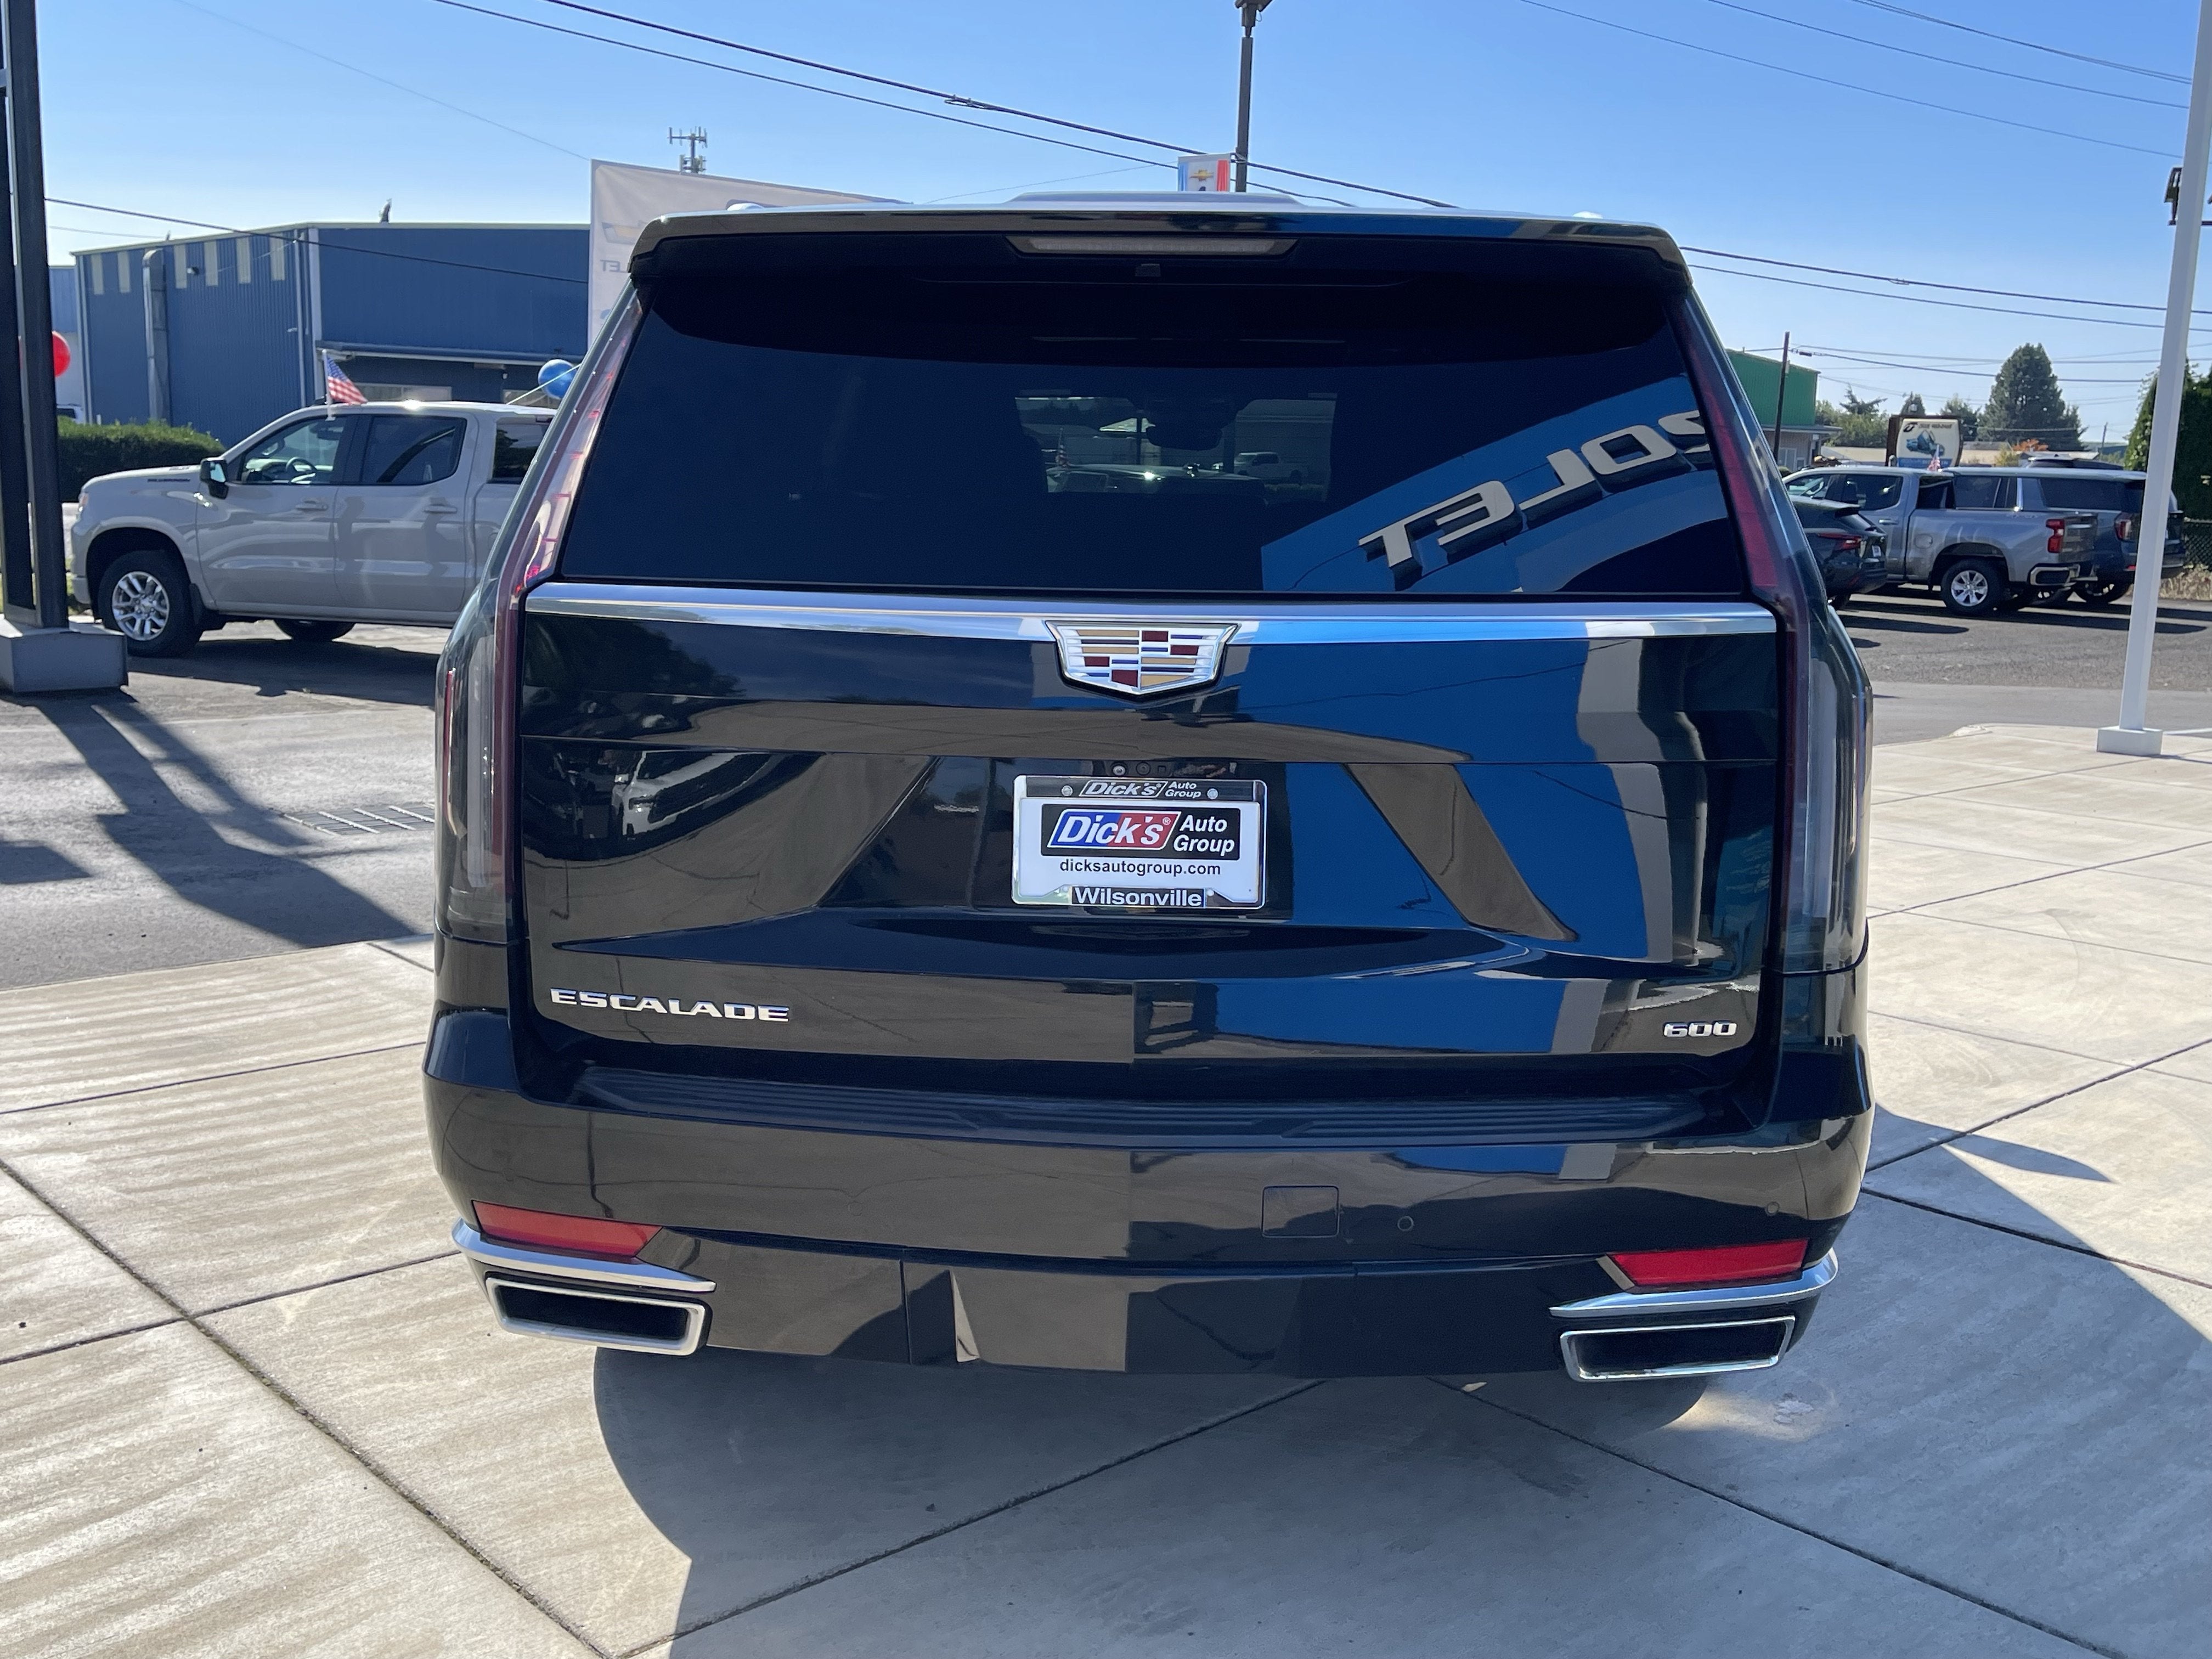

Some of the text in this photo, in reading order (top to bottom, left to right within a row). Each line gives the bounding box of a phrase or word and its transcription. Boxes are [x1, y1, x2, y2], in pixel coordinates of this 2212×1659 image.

[1085, 782, 1157, 795] Dick's
[1165, 789, 1201, 799] Group
[1168, 781, 1197, 789] Auto
[1057, 814, 1164, 845] Dick's
[1179, 815, 1228, 833] Auto
[1173, 834, 1235, 857] Group
[1059, 859, 1221, 877] dicksautogroup.com
[1074, 887, 1203, 907] Wilsonville
[550, 988, 789, 1022] ESCALADE
[1663, 1021, 1737, 1037] 600
